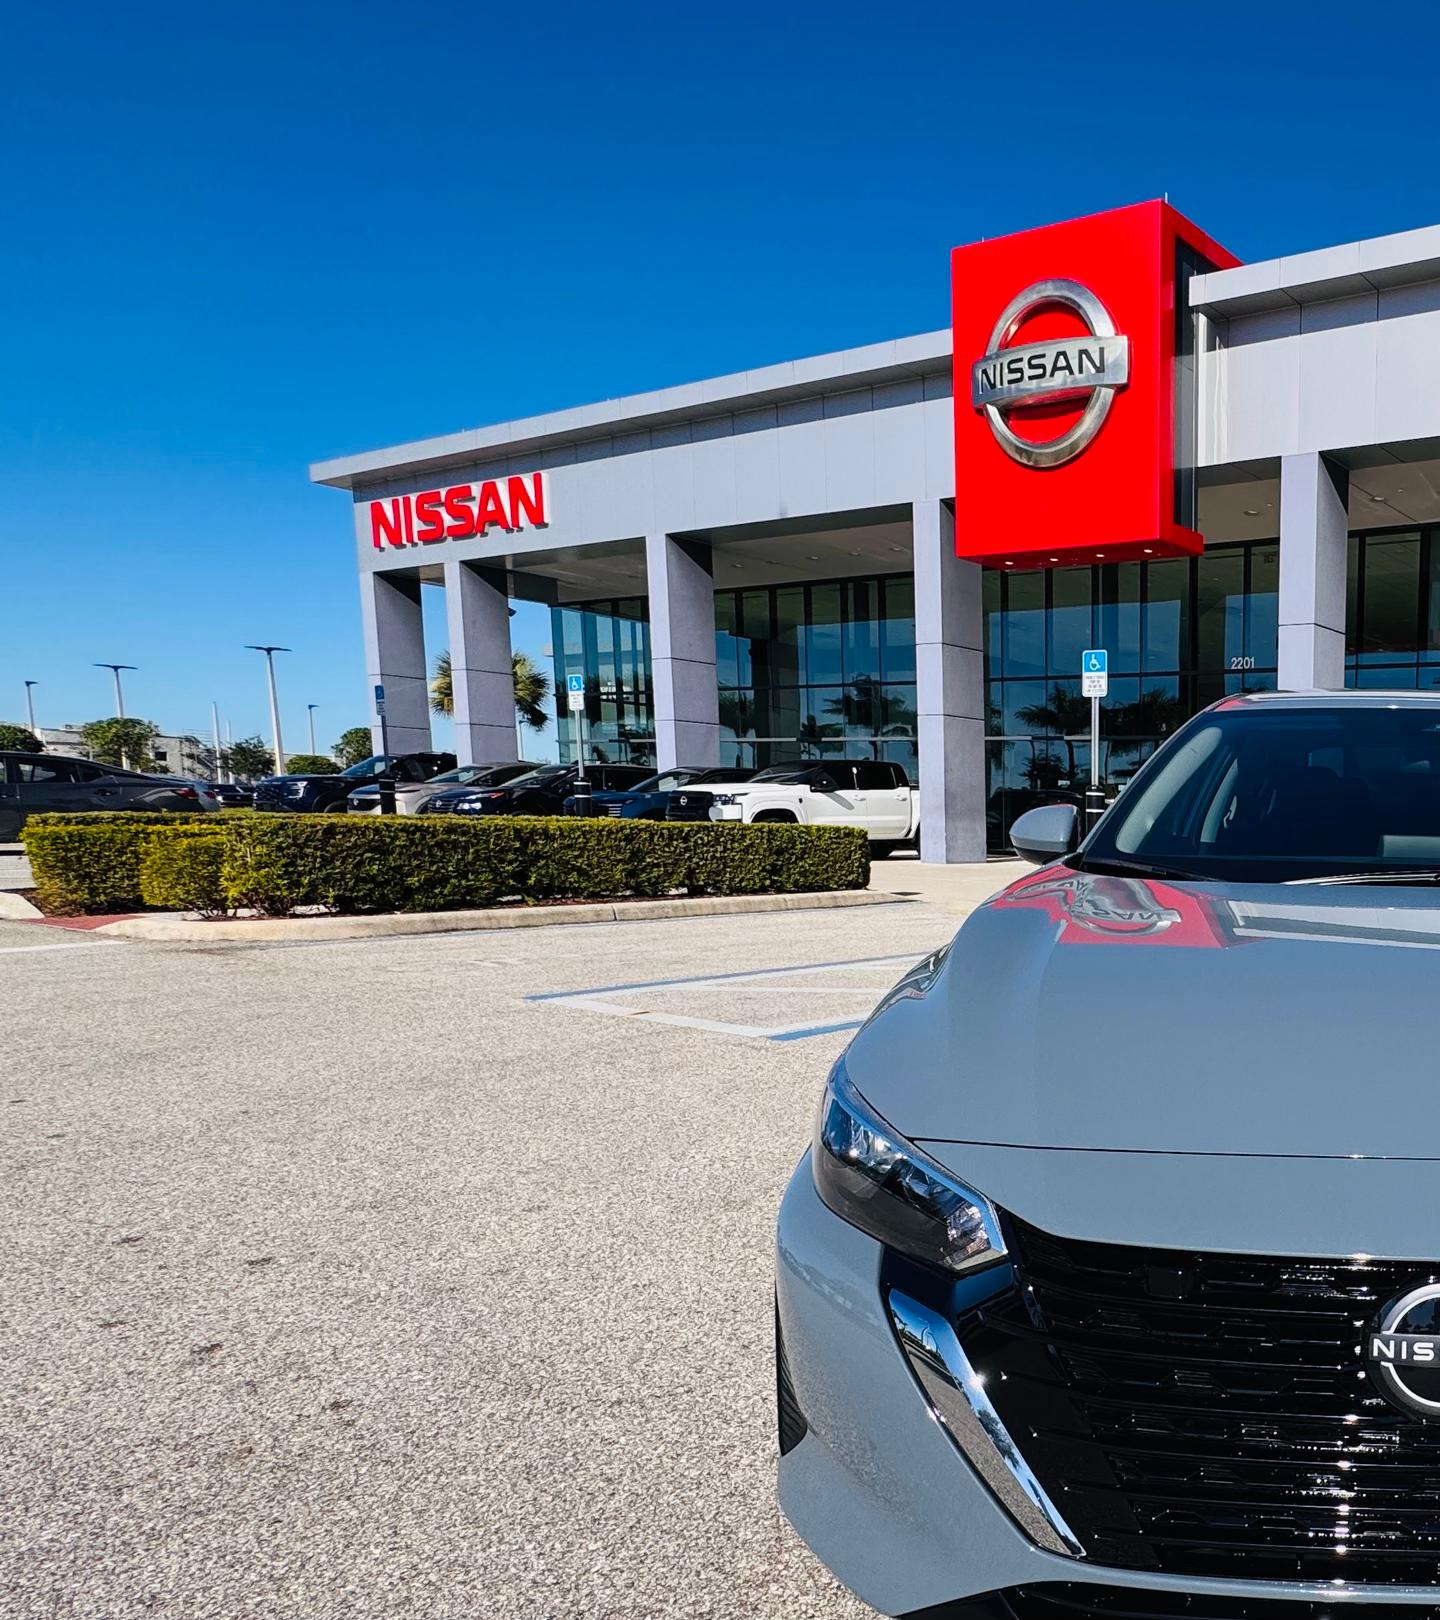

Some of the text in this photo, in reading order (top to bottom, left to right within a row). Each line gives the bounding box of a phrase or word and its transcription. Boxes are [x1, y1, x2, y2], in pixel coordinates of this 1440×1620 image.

[980, 346, 1106, 393] NISSAN
[370, 472, 545, 548] NISSAN
[1230, 656, 1255, 670] 2201
